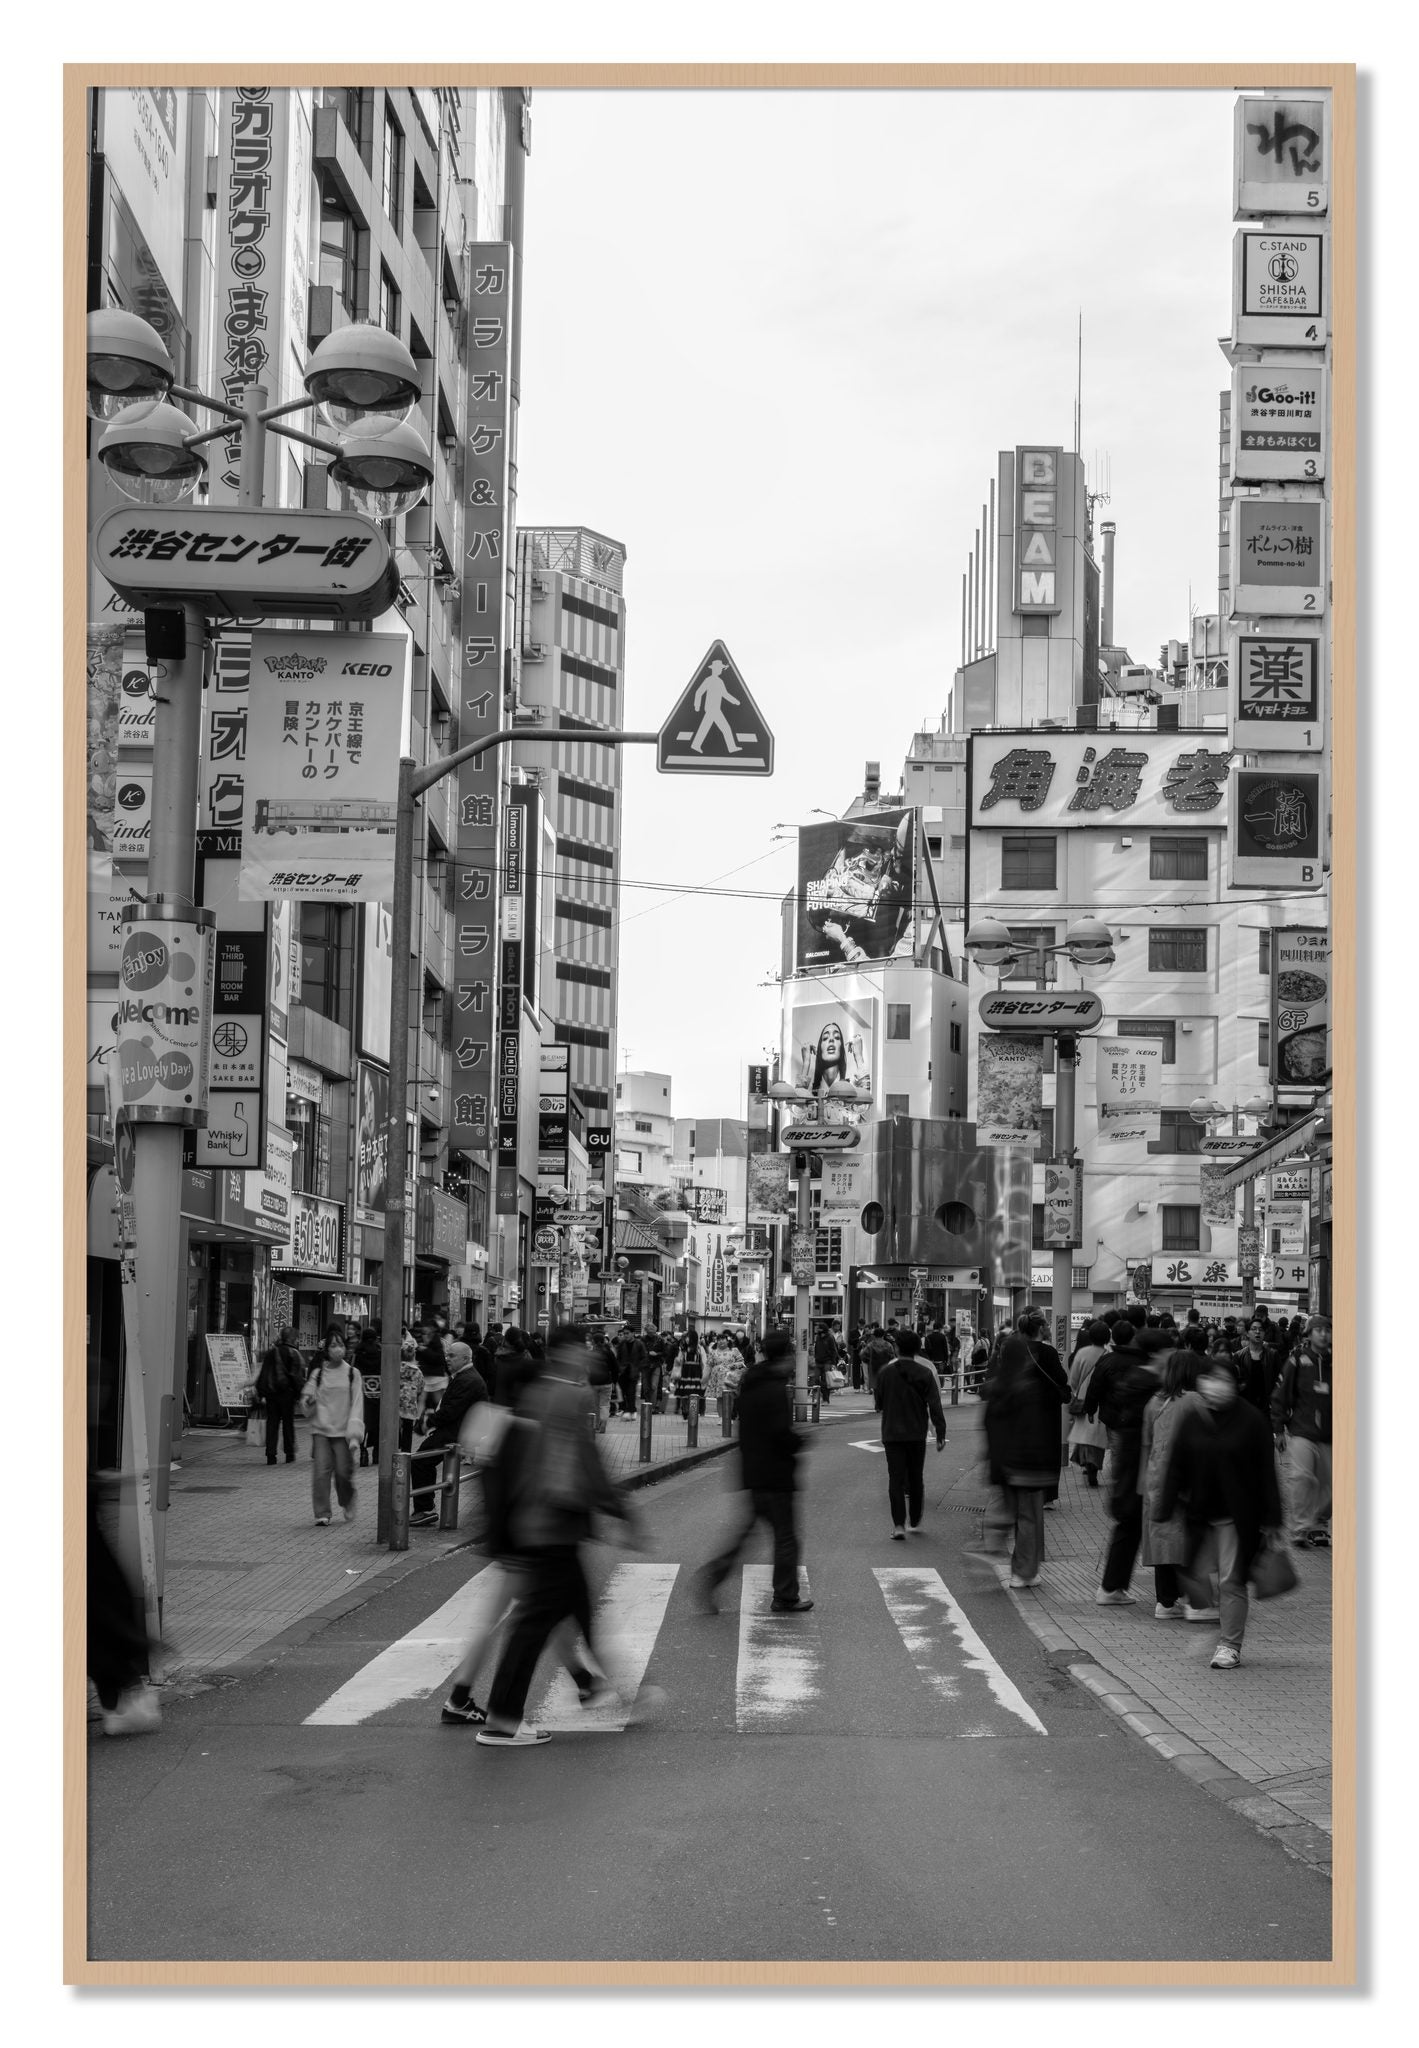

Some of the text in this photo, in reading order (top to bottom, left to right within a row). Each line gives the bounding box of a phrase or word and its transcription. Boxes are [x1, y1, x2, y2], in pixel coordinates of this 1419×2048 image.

[229, 100, 271, 246] カラオケ
[1306, 191, 1320, 207] 5
[1259, 241, 1307, 252] C.STAND
[1259, 285, 1307, 296] SHISHA
[1259, 296, 1307, 305] CAFE&BAR
[1304, 324, 1318, 341] 4
[1257, 387, 1316, 404] Goo-it!
[1250, 408, 1313, 419] 渋谷宇田川町店
[1245, 434, 1317, 448] 全身もみほぐし
[1303, 459, 1318, 477] 3
[1021, 451, 1056, 605] BEAM
[109, 527, 373, 568] 渋谷センター街
[1246, 535, 1314, 556] ポムの樹
[1257, 559, 1306, 568] Pomme-no-ki
[1303, 594, 1316, 610] 2
[277, 671, 316, 680] KANTO
[341, 662, 393, 677] KEIO
[1249, 645, 1304, 699] 薬
[1243, 702, 1309, 718] マツモトキヨシ
[281, 700, 300, 746] 冒険へ
[123, 730, 149, 739] 渋谷店
[301, 700, 321, 780] カントーの
[323, 700, 343, 780] ポケパーク
[346, 701, 364, 765] 京王線で
[1302, 730, 1312, 746] 1
[979, 746, 1230, 811] 角海老
[118, 843, 145, 853] 渋谷店
[508, 810, 517, 890] kimono hearts
[269, 873, 363, 887] 渋谷センター街
[1301, 865, 1314, 882] B
[225, 944, 241, 953] THE
[122, 946, 166, 984] Enjoy
[221, 953, 245, 961] THIRD
[220, 982, 243, 991] ROOM
[223, 994, 240, 1002] BAR
[119, 999, 200, 1026] Welcome
[987, 1001, 1096, 1015] 渋谷センター街
[1278, 1010, 1308, 1031] 6F
[137, 1061, 169, 1081] Lovely
[170, 1062, 192, 1077] Day!
[208, 1130, 243, 1142] Whisky
[588, 1133, 610, 1146] GU
[207, 1140, 229, 1149] Bank
[713, 1258, 723, 1304] BEER
[711, 1304, 725, 1313] HALL
